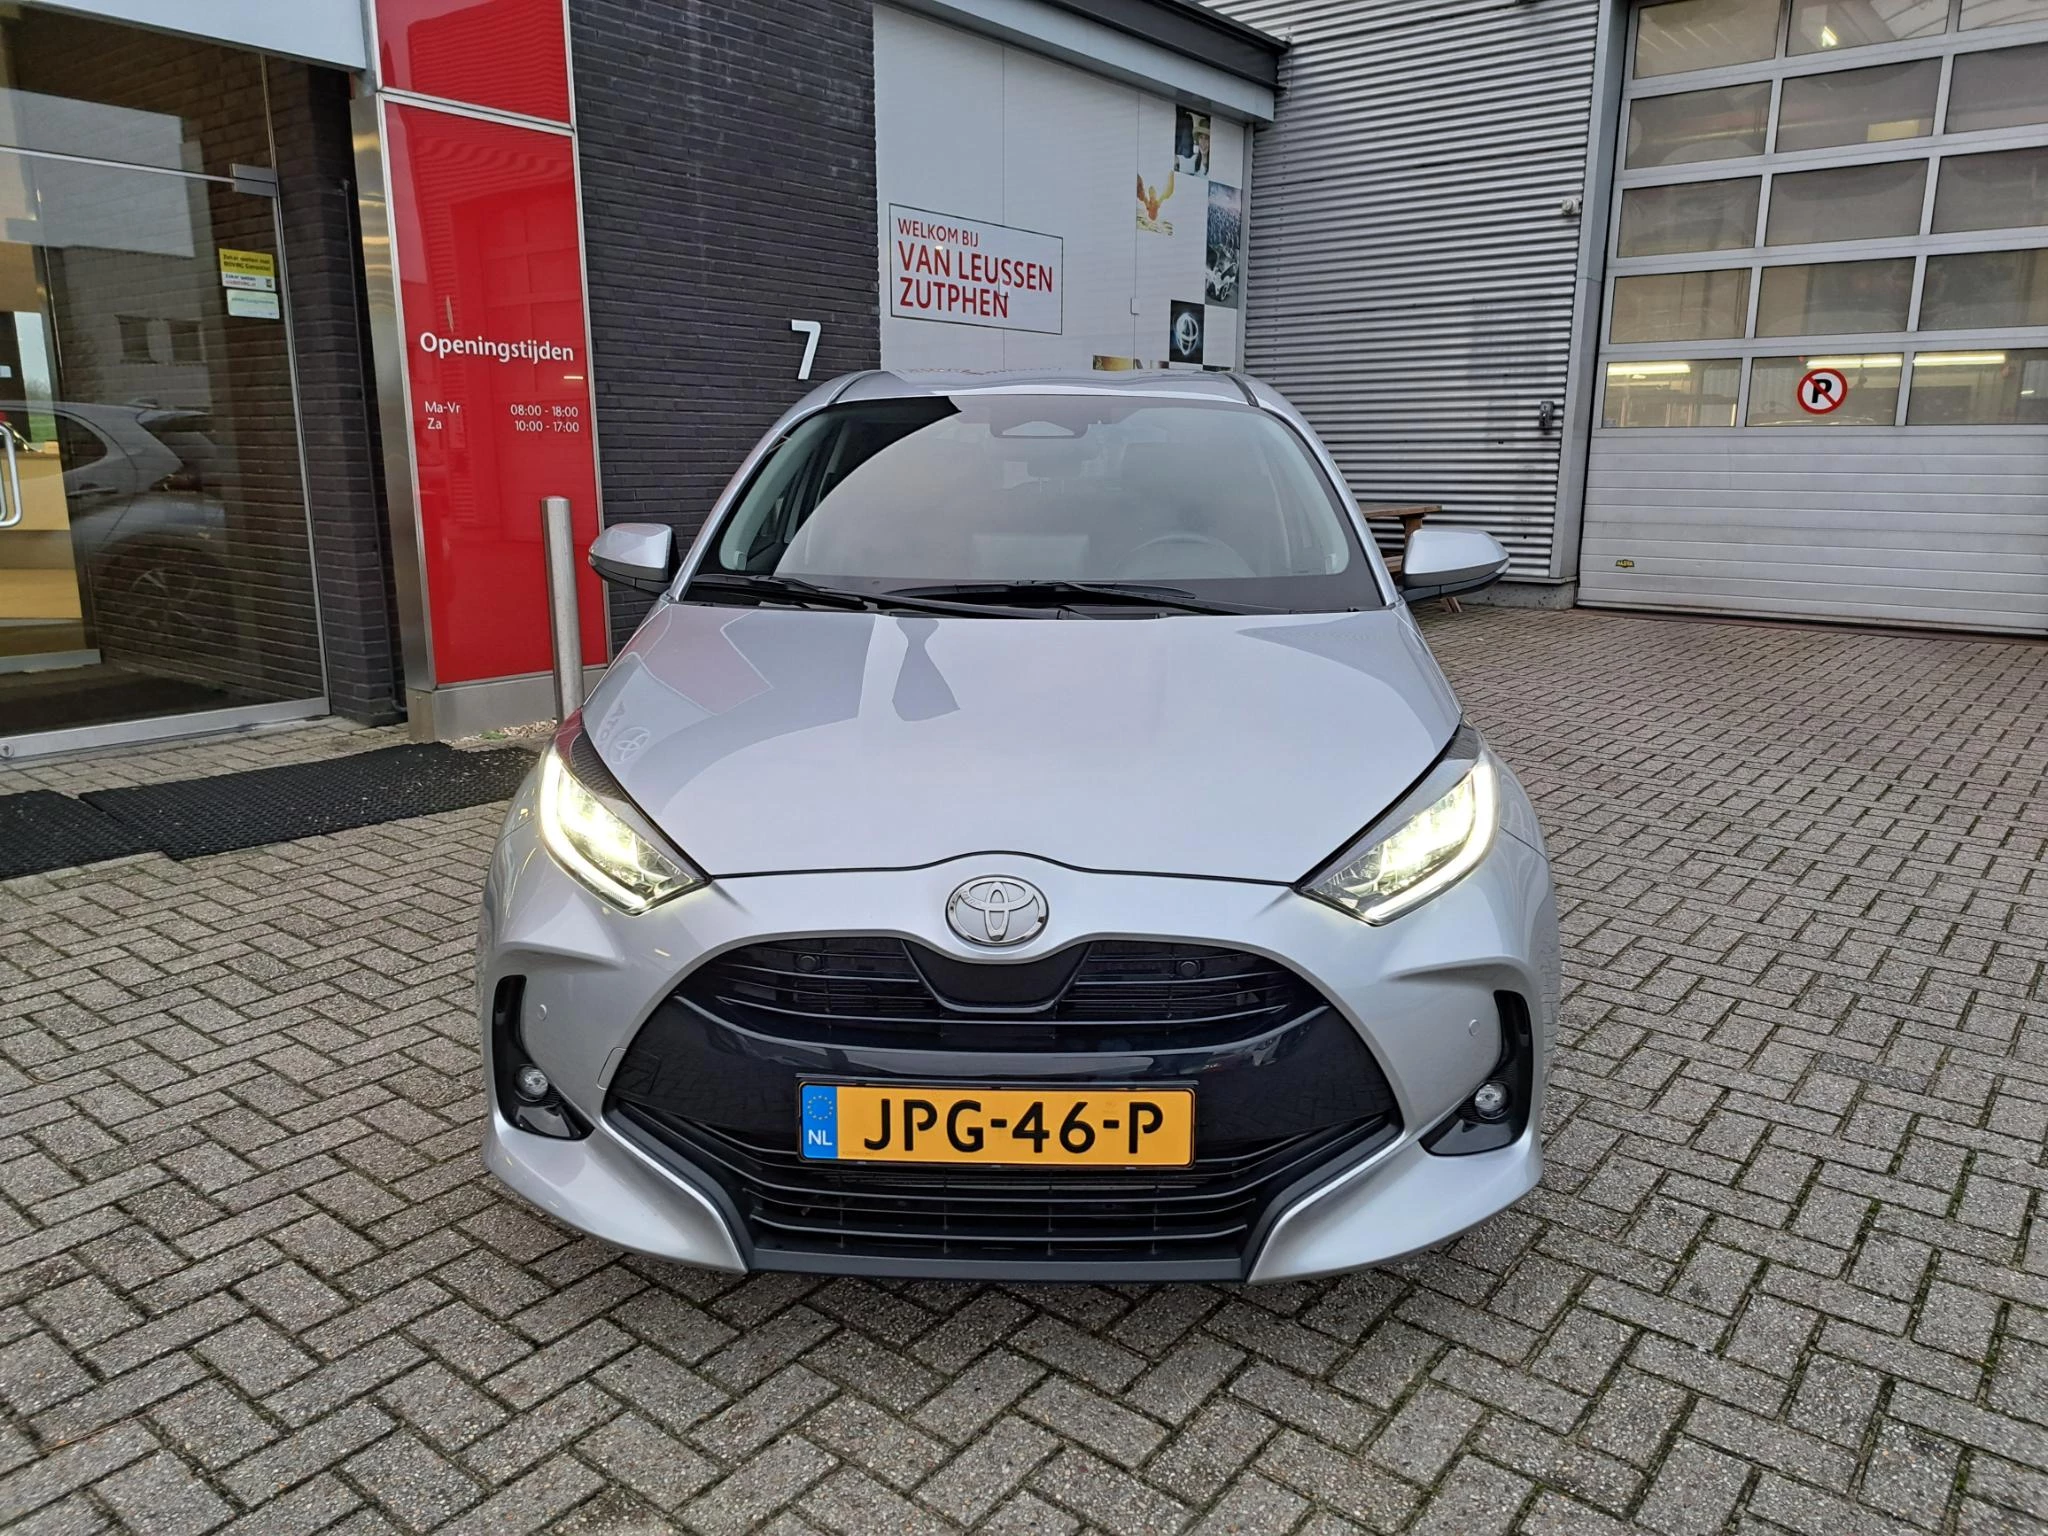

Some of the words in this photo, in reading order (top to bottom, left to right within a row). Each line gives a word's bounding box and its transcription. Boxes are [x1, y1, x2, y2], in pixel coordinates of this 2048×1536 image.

[897, 218, 959, 244] WELKOM
[962, 229, 980, 248] BIJ
[897, 240, 951, 277] VAN
[958, 250, 1053, 293] LEUSSEN
[899, 276, 1009, 319] ZUTPHEN
[420, 332, 574, 364] Openingstijden
[791, 319, 822, 380] 7
[424, 400, 461, 414] Ma-Vr
[510, 404, 542, 417] 08:00
[552, 405, 579, 418] 18:00
[427, 417, 442, 430] Za
[514, 420, 543, 432] 10:00
[553, 421, 580, 433] 17:00
[807, 1129, 833, 1146] NL
[863, 1098, 1164, 1154] JPG-46-P
